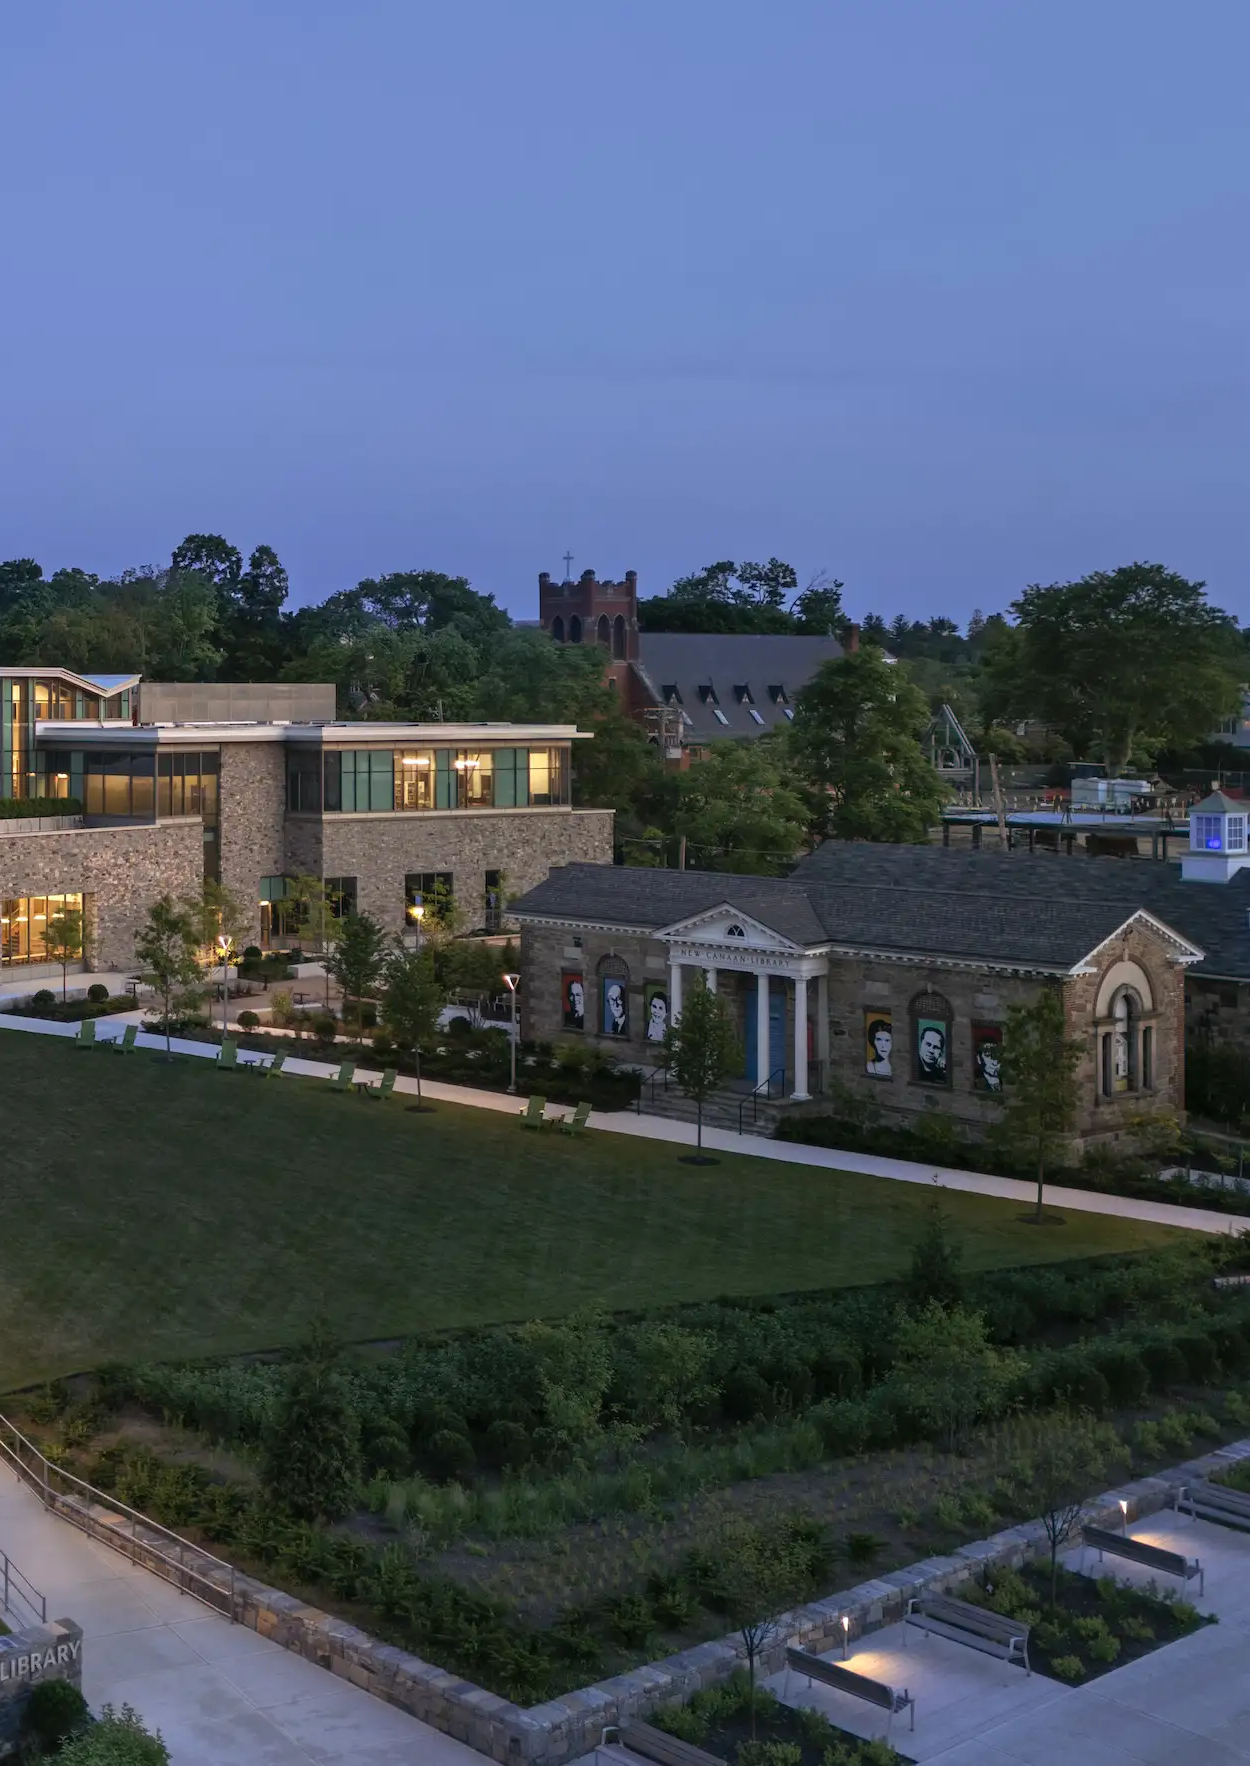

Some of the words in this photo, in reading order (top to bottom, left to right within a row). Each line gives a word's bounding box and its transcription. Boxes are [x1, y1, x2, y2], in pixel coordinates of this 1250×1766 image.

[681, 949, 700, 957] NEW
[706, 952, 745, 963] CANAAN
[751, 957, 790, 967] LIBRARY
[0, 1640, 81, 1681] LIBRARY
